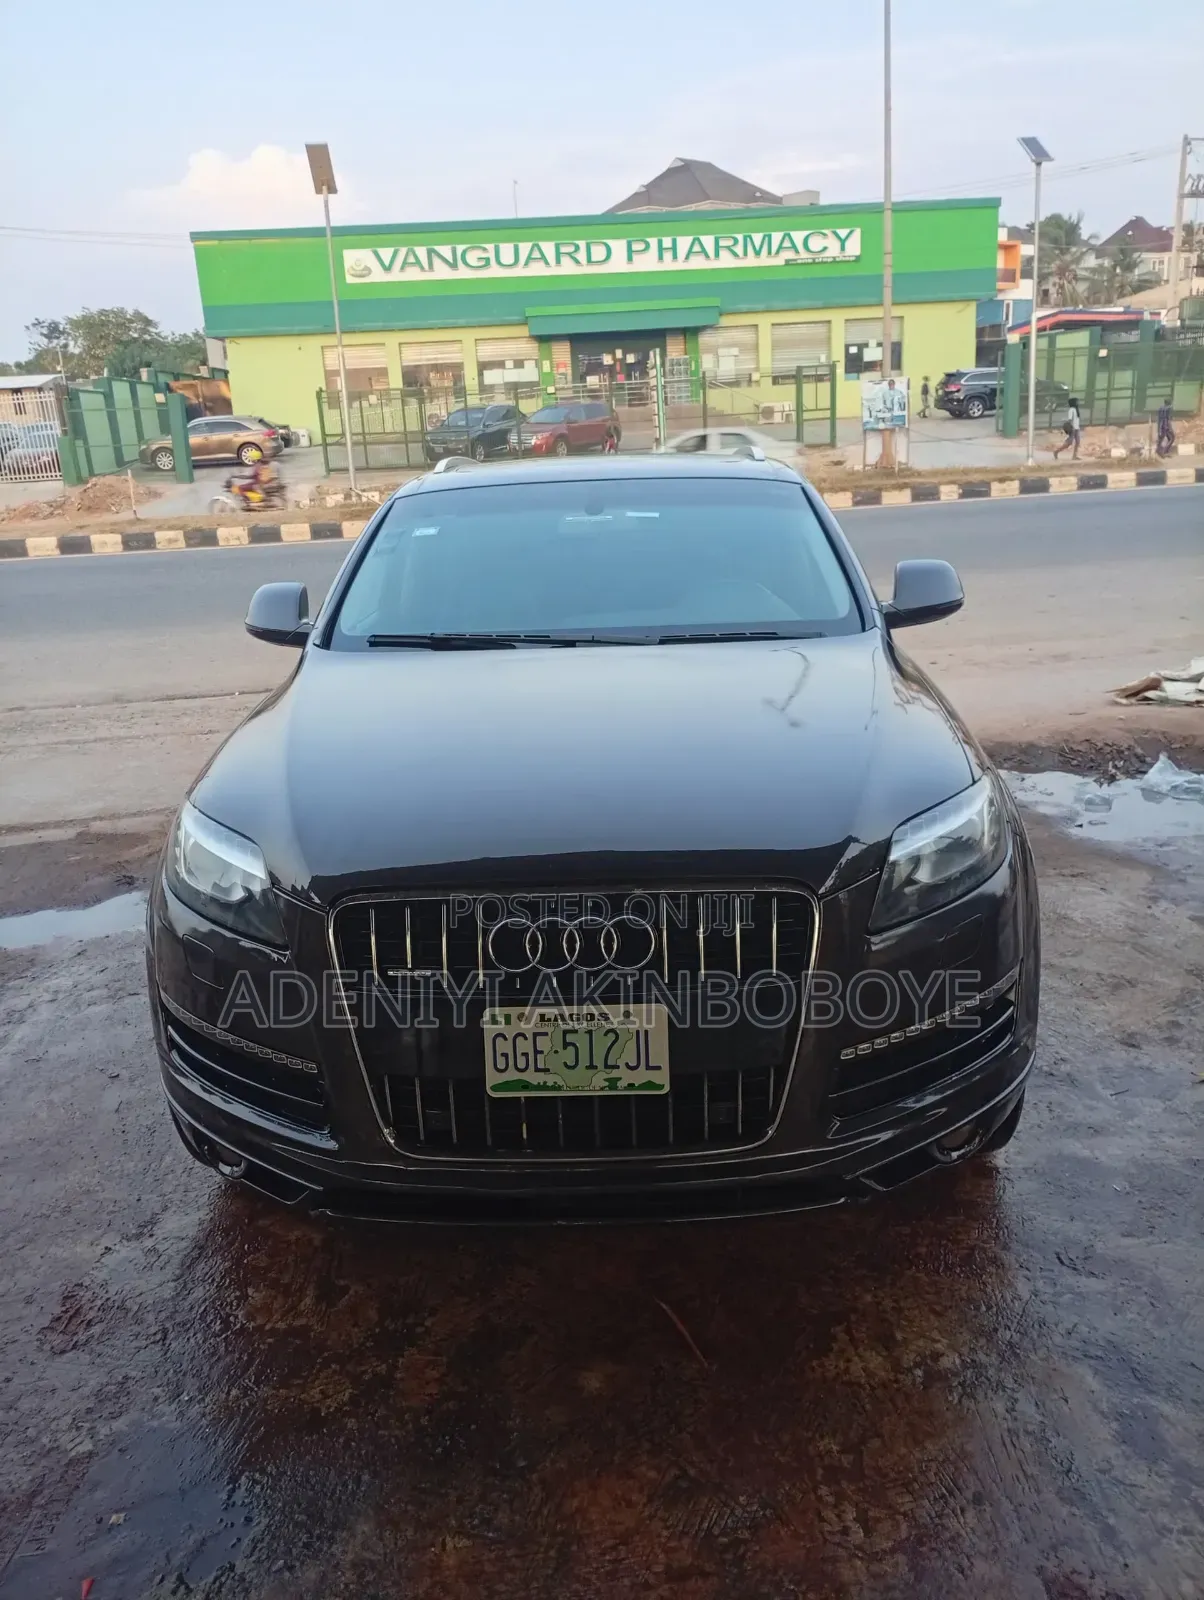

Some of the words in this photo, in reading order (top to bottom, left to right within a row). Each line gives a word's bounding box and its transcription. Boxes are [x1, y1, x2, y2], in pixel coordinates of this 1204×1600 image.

[371, 240, 612, 273] VANGUARD
[626, 229, 856, 264] PHARMACY
[539, 1012, 611, 1023] LAGOS
